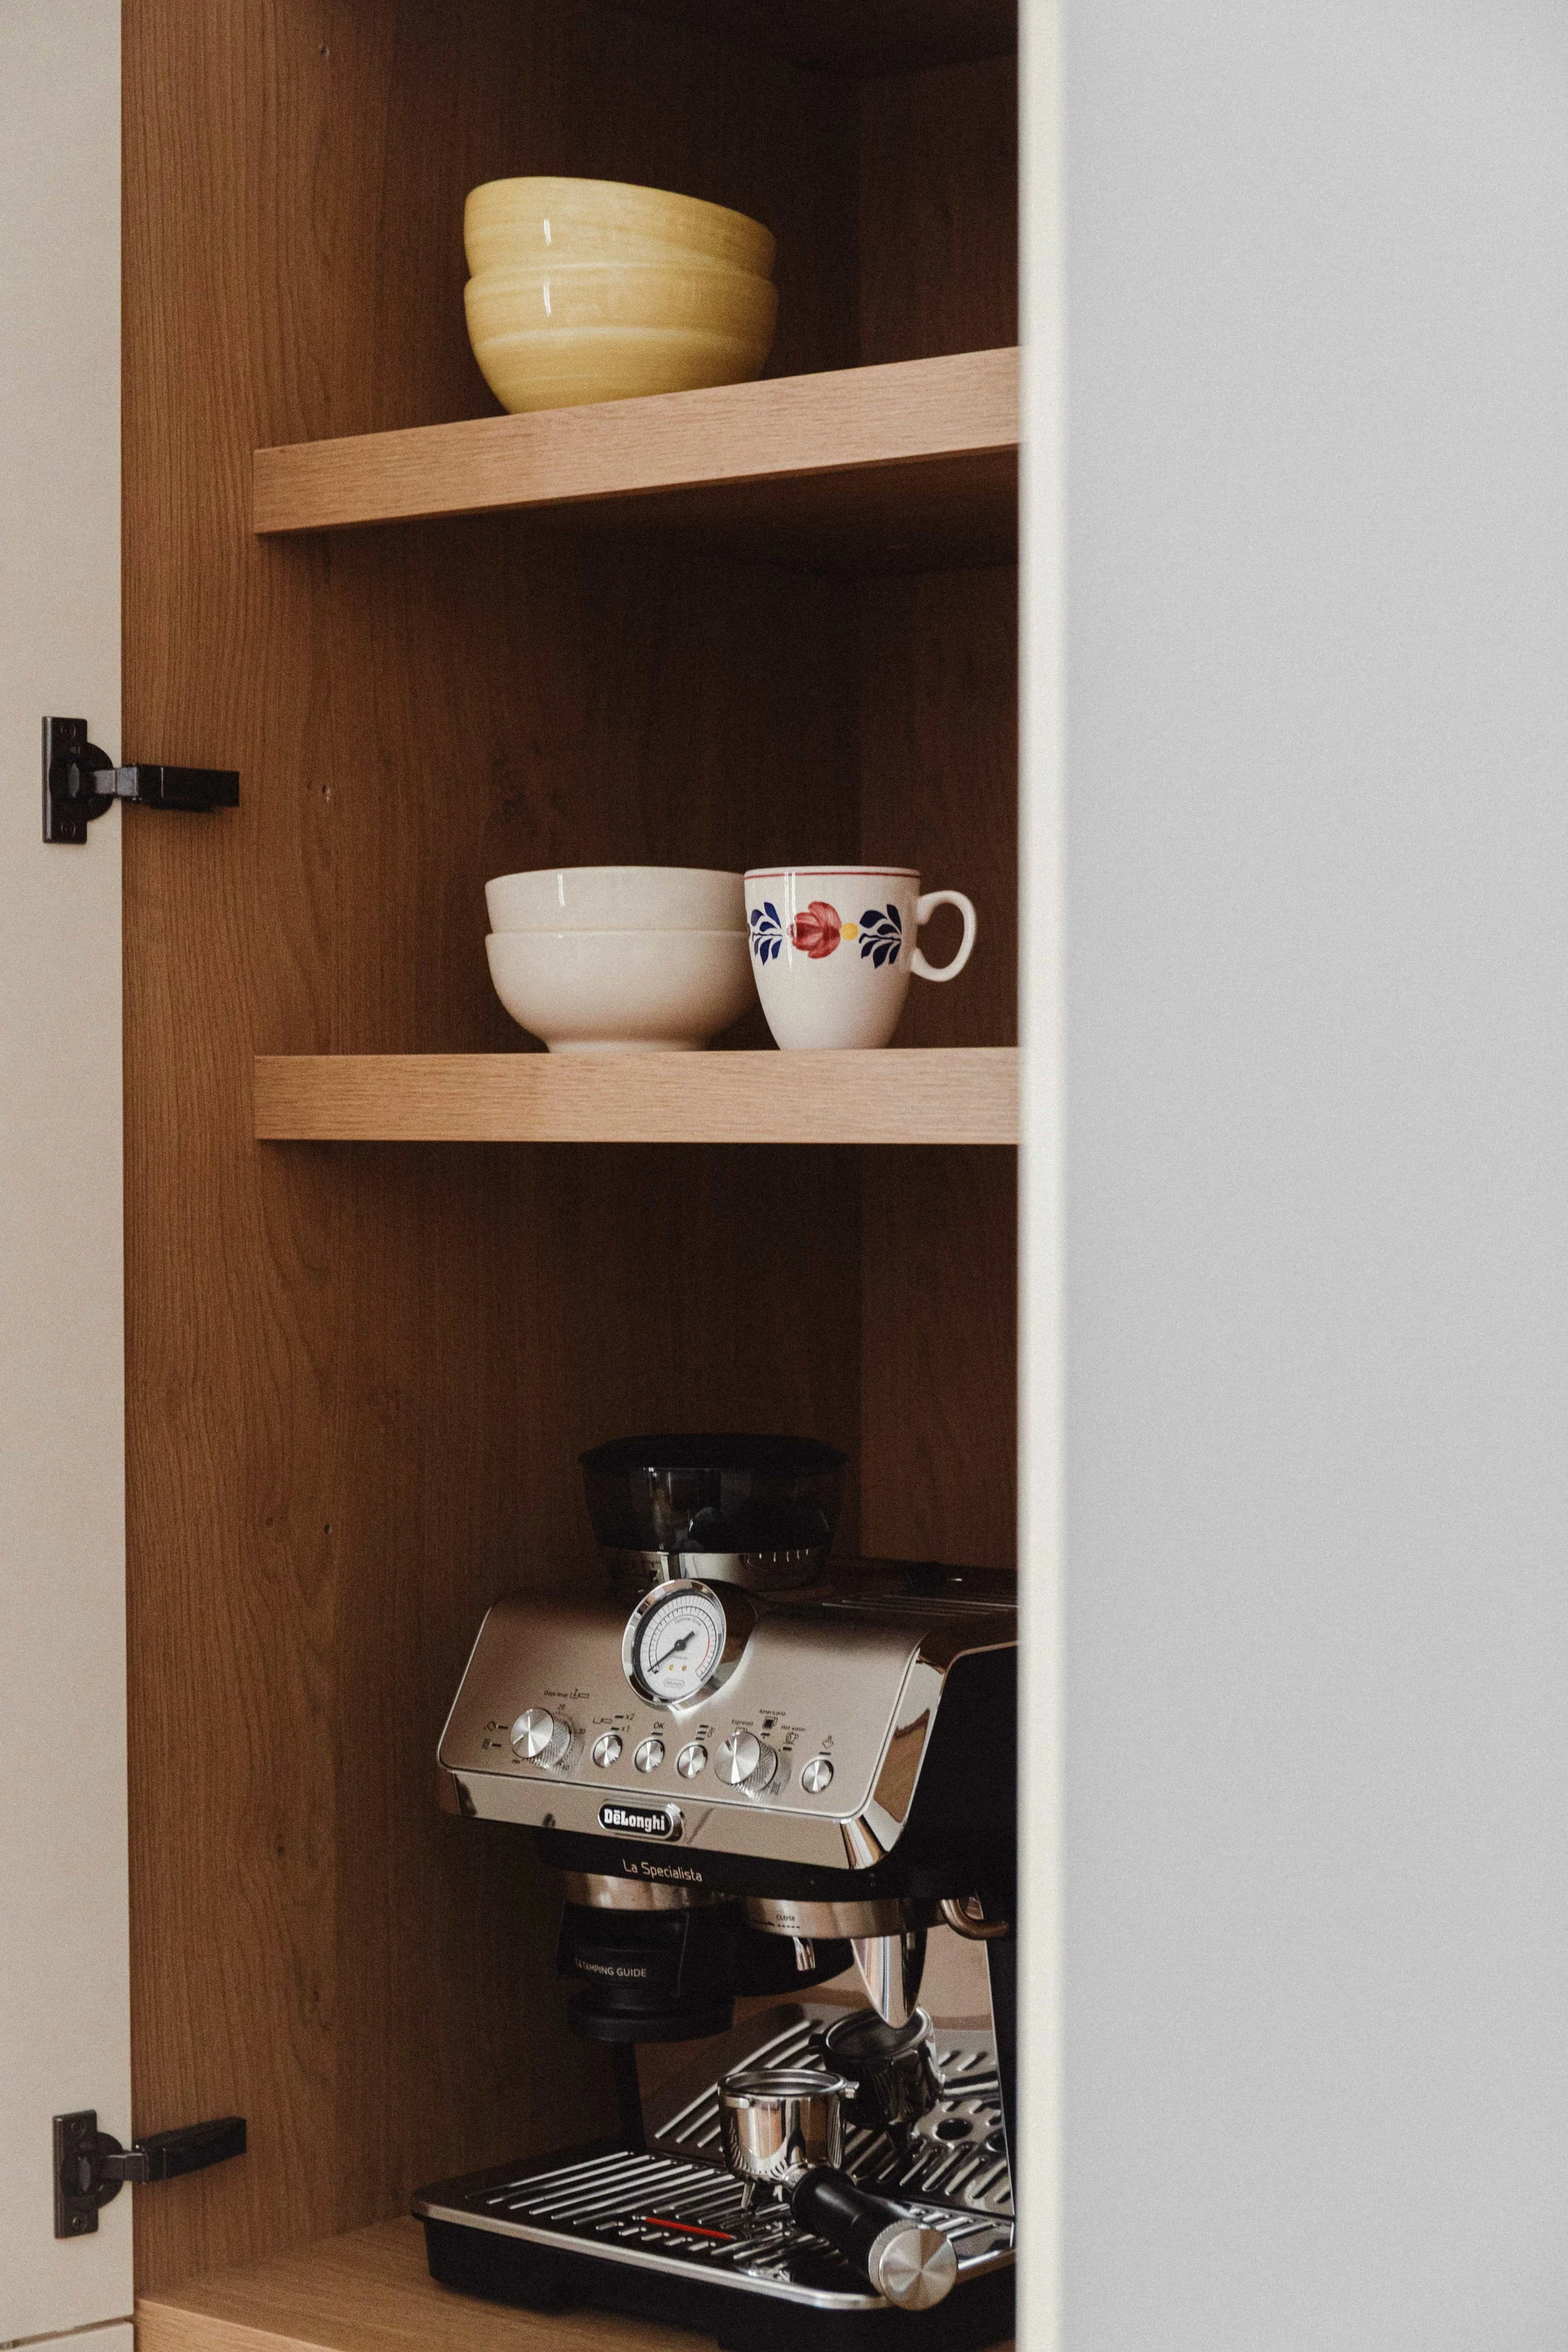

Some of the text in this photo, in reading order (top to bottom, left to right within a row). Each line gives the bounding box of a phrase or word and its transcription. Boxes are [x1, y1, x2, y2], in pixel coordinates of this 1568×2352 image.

[759, 1708, 786, 1717] Americano
[622, 1859, 703, 1882] La Specialista
[616, 1967, 647, 1977] GUIDE
